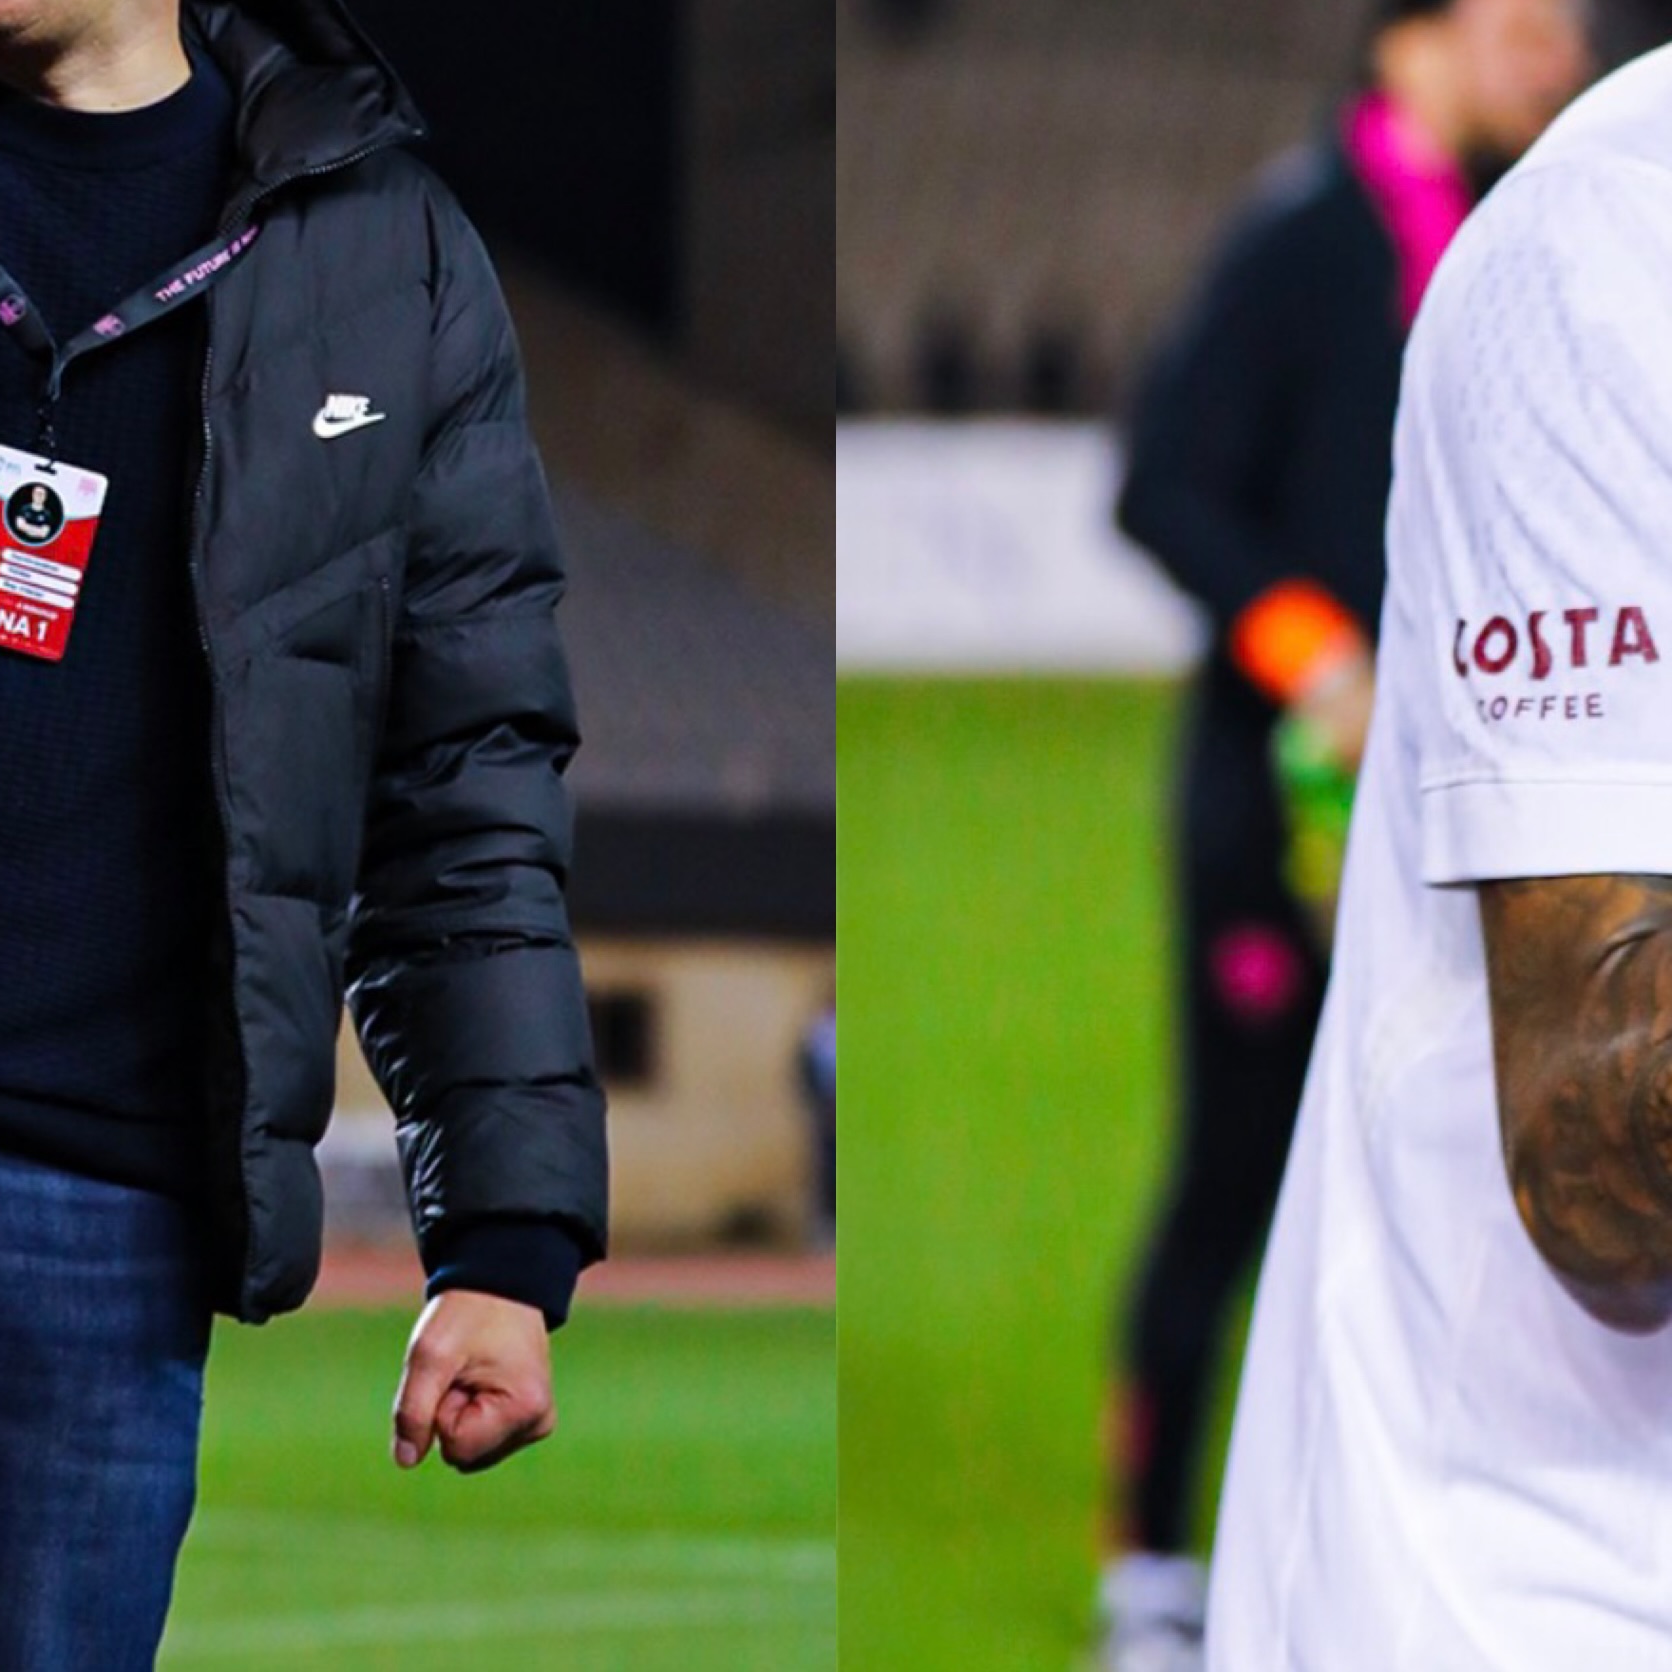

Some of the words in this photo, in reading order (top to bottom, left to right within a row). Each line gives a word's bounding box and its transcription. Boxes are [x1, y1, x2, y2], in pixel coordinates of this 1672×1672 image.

[325, 393, 371, 419] NIKE
[37, 620, 48, 642] 1
[1452, 605, 1661, 682] COSTA
